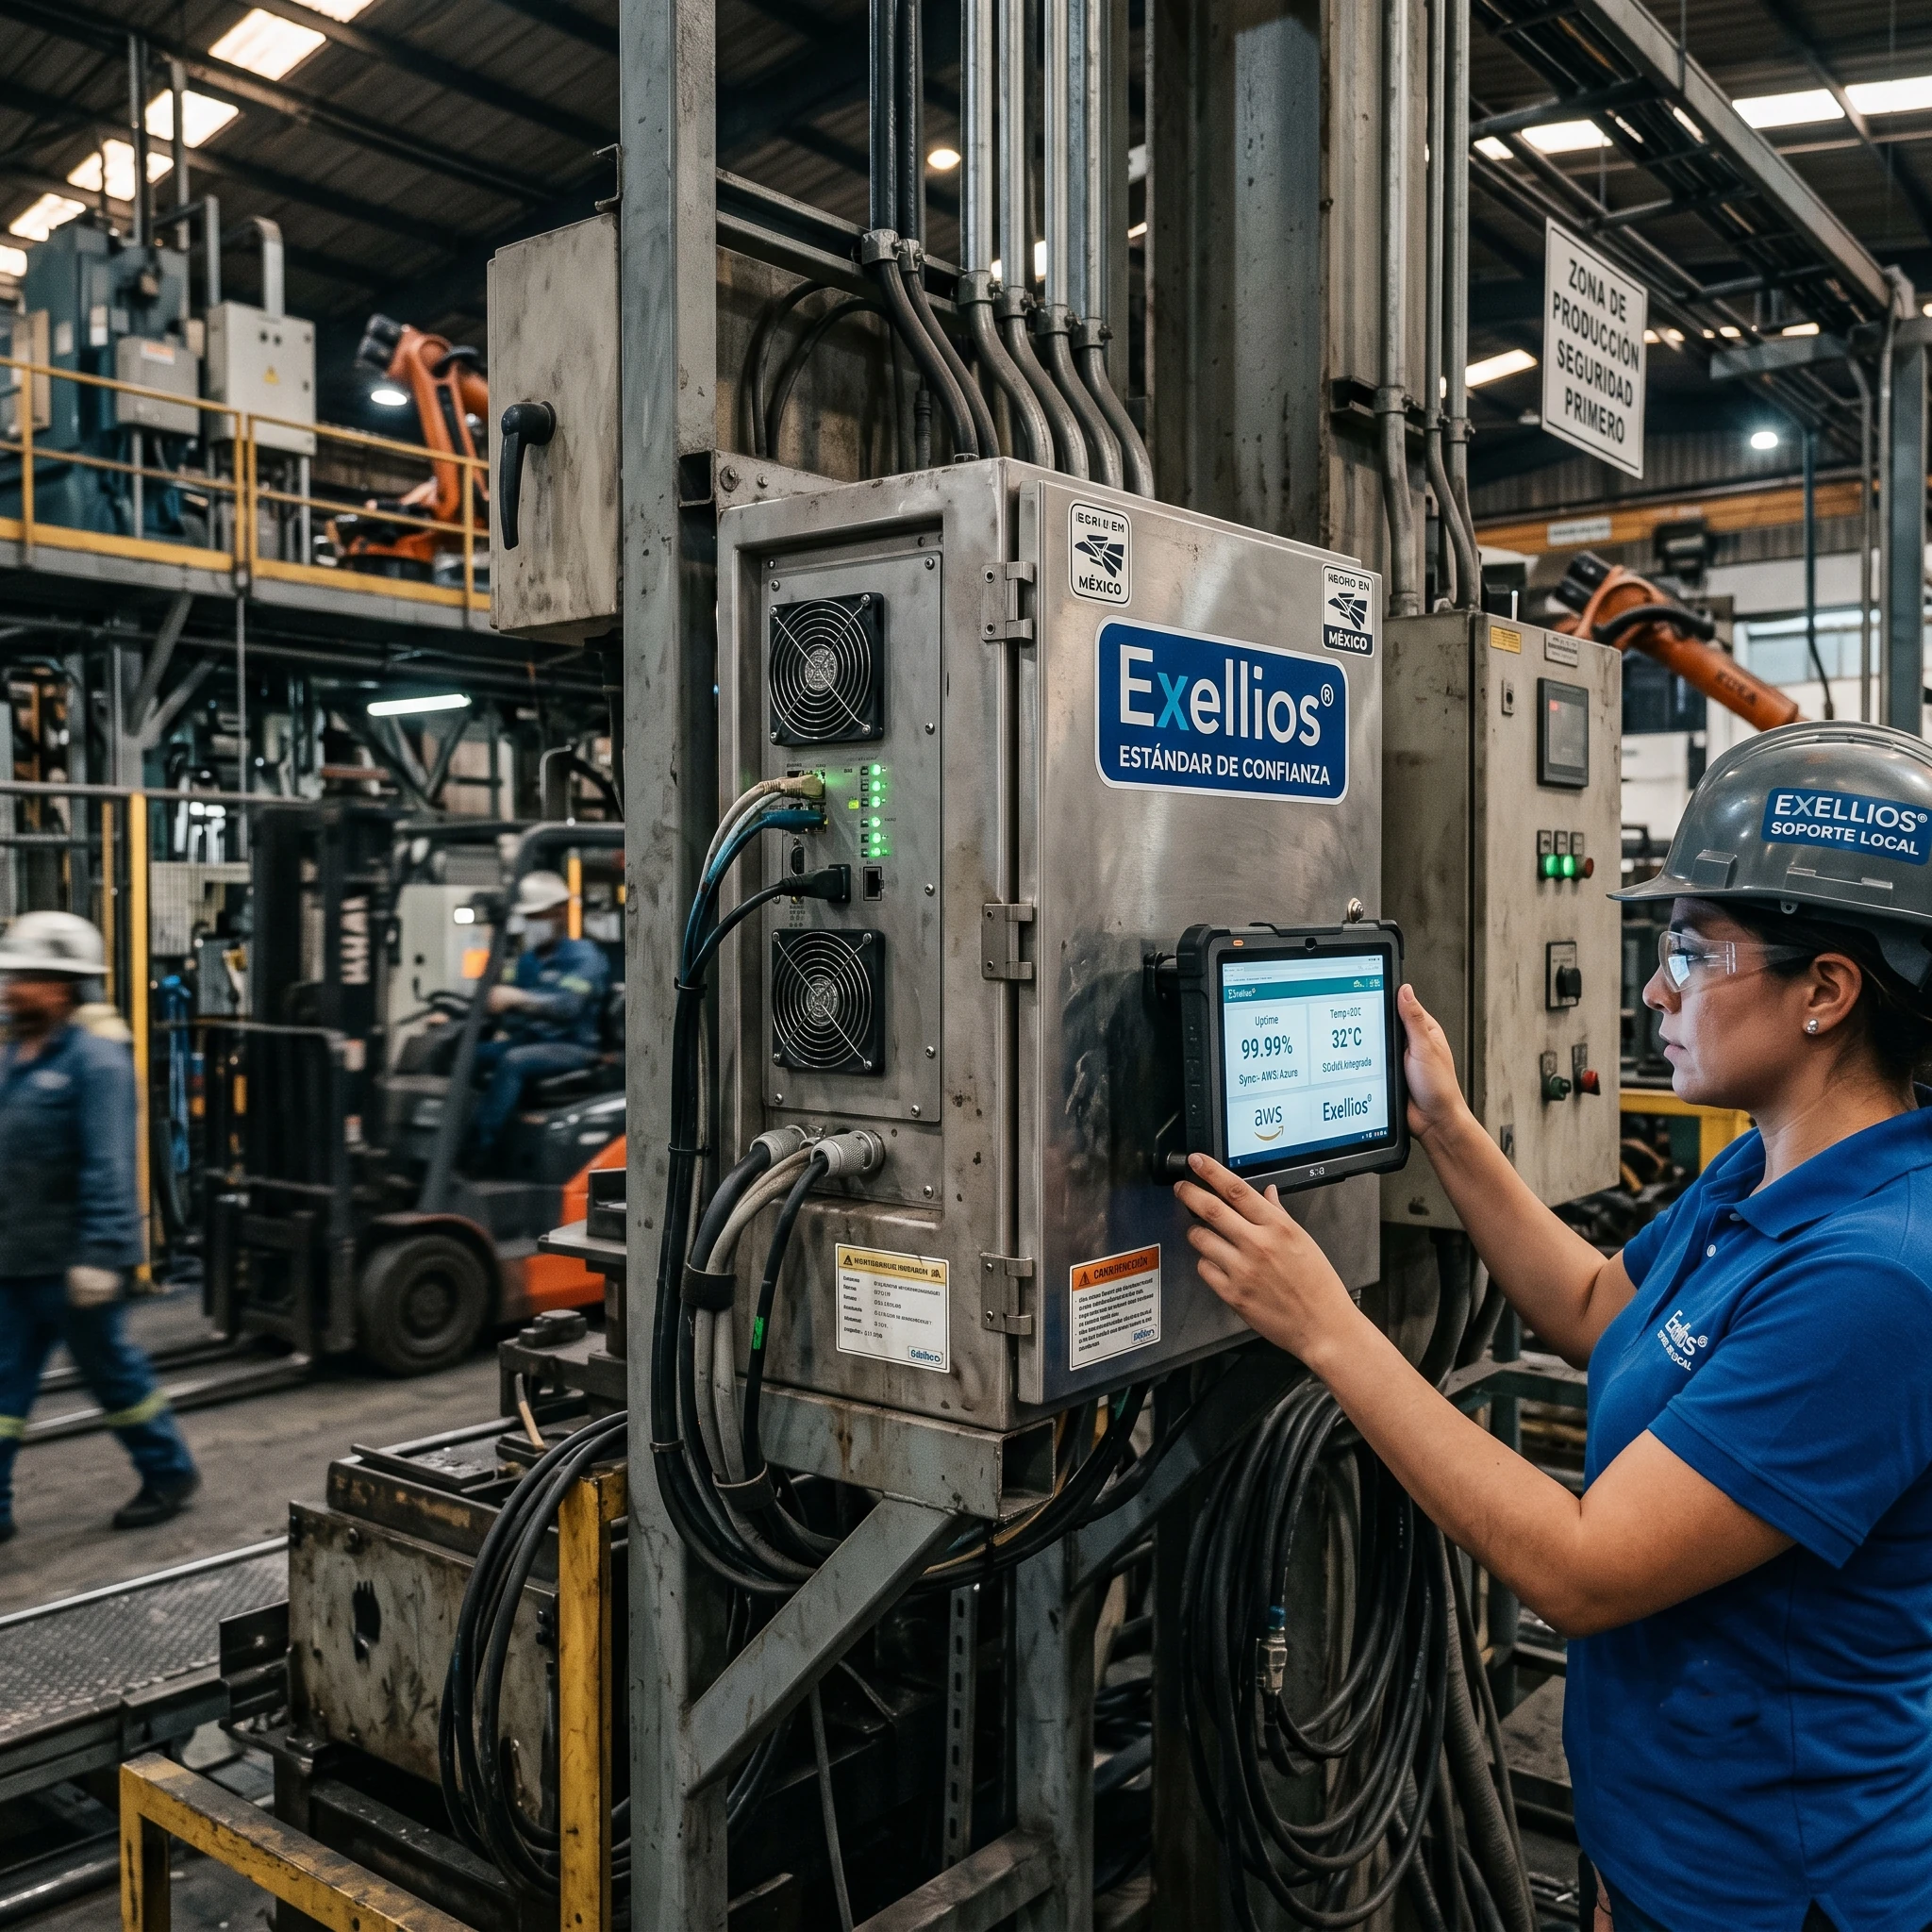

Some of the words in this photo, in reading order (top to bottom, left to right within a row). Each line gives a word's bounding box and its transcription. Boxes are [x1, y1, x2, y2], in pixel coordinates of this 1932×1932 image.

[1569, 258, 1606, 311] ZONA
[1609, 287, 1626, 324] DE
[1553, 290, 1640, 374] PRODUCCIÓN
[1557, 339, 1633, 408] SEGURIDAD
[1565, 386, 1624, 445] PRIMERO
[1078, 574, 1122, 595] MÉXICO
[1328, 629, 1368, 651] MÉXICO
[1120, 643, 1334, 747] Exellios®
[1120, 742, 1213, 775] ESTÁNDAR
[1217, 754, 1239, 777] DE
[1242, 758, 1331, 786] CONFIANZA
[1771, 821, 1857, 842] SOPORTE
[1859, 831, 1920, 856] LOCAL
[1241, 1035, 1293, 1059] 99.99%
[1331, 1026, 1362, 1049] 32°C
[1254, 1105, 1284, 1126] aws
